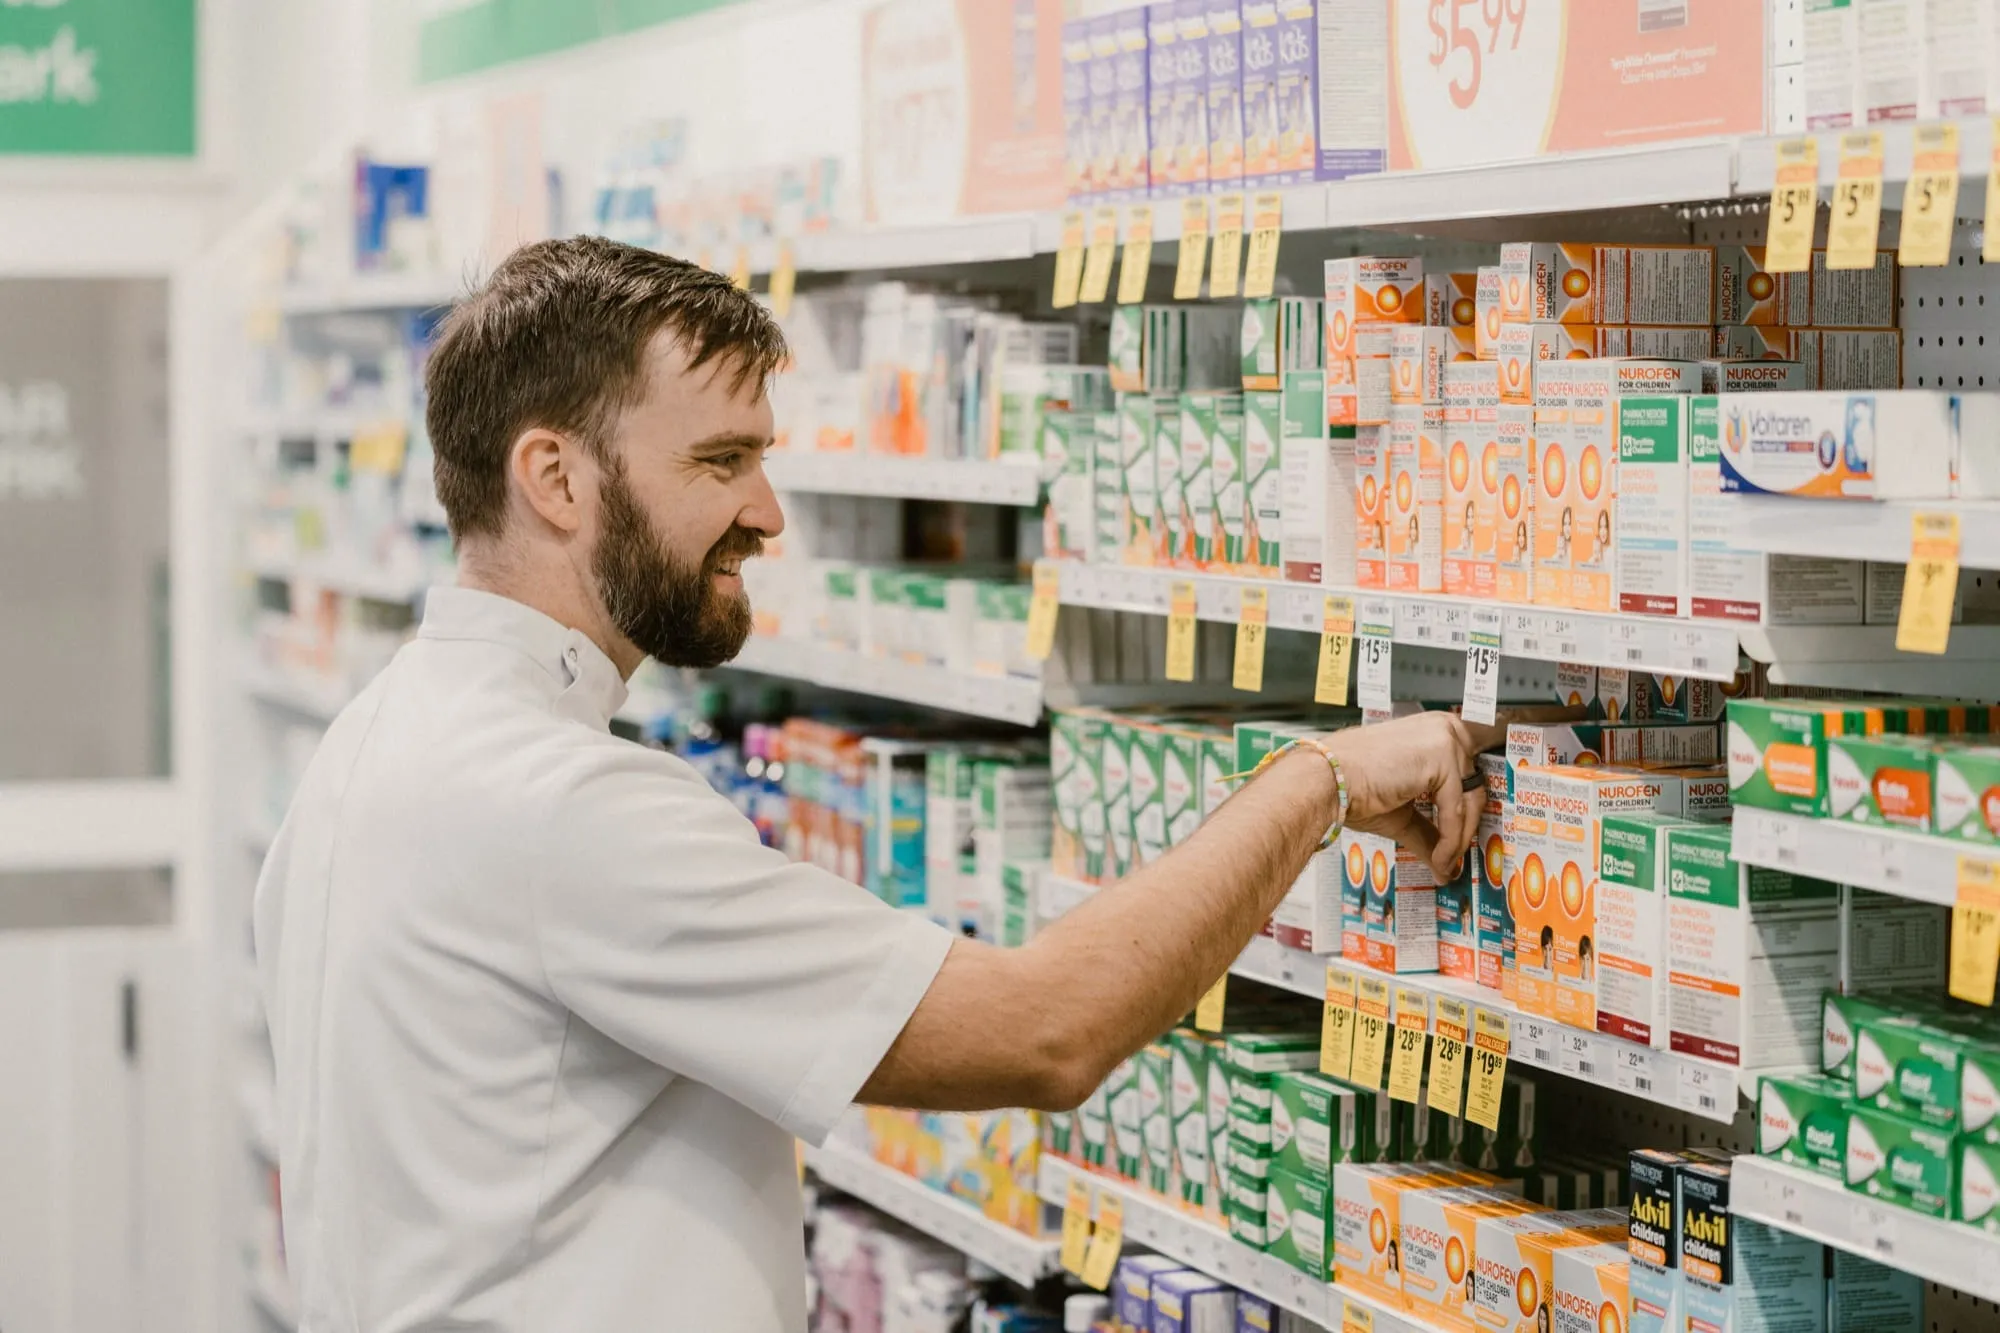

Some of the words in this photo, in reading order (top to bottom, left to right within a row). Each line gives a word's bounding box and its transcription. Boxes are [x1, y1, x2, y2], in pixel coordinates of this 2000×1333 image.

[1360, 262, 1407, 271] NUROFEN
[1536, 263, 1546, 318] NUROFEN
[1722, 266, 1731, 320] NUROFEN
[1428, 346, 1438, 398] NUROFEN
[1618, 368, 1681, 379] NUROFEN
[1727, 368, 1786, 380] NUROFEN
[1444, 383, 1474, 397] NUROFEN
[1539, 382, 1573, 397] NUROFEN
[1574, 383, 1609, 398] NUROFEN
[1635, 381, 1670, 389] CHILDREN
[1743, 381, 1777, 389] CHILDREN
[1749, 409, 1812, 436] Voltaren
[1636, 682, 1646, 720] OFEN
[1509, 731, 1540, 745] NUROFEN
[1517, 745, 1534, 753] CHILDREN
[1599, 784, 1661, 798] NUROFEN
[1689, 784, 1728, 796] NURO
[1516, 790, 1551, 808] NUROFEN
[1599, 799, 1613, 808] FOR
[1615, 799, 1651, 807] CHILDREN
[1689, 798, 1704, 806] FOR
[1516, 805, 1525, 814] FOR
[1525, 807, 1546, 818] CHILDREN
[1554, 799, 1589, 816] NUROFEN
[1554, 812, 1562, 821] FOR
[1562, 814, 1583, 826] CHILDREN
[1490, 907, 1502, 917] years
[1437, 1036, 1461, 1062] $2889
[1477, 1034, 1506, 1053] CATALOGUE
[1477, 1050, 1502, 1075] $1989
[1630, 1191, 1670, 1230] Advil
[1631, 1221, 1665, 1247] children
[1684, 1208, 1726, 1246] Advil
[1405, 1224, 1443, 1250] NUROFEN
[1415, 1244, 1436, 1260] CHILDREN
[1684, 1238, 1721, 1263] children
[1412, 1255, 1427, 1268] YEARS
[1476, 1256, 1516, 1287] NUROFEN
[1476, 1275, 1485, 1286] FOR
[1486, 1278, 1511, 1298] CHILDREN
[1483, 1288, 1498, 1304] YEARS
[1555, 1289, 1598, 1320] NUROFEN
[1555, 1308, 1565, 1320] FOR
[1566, 1313, 1592, 1332] CHILDREN
